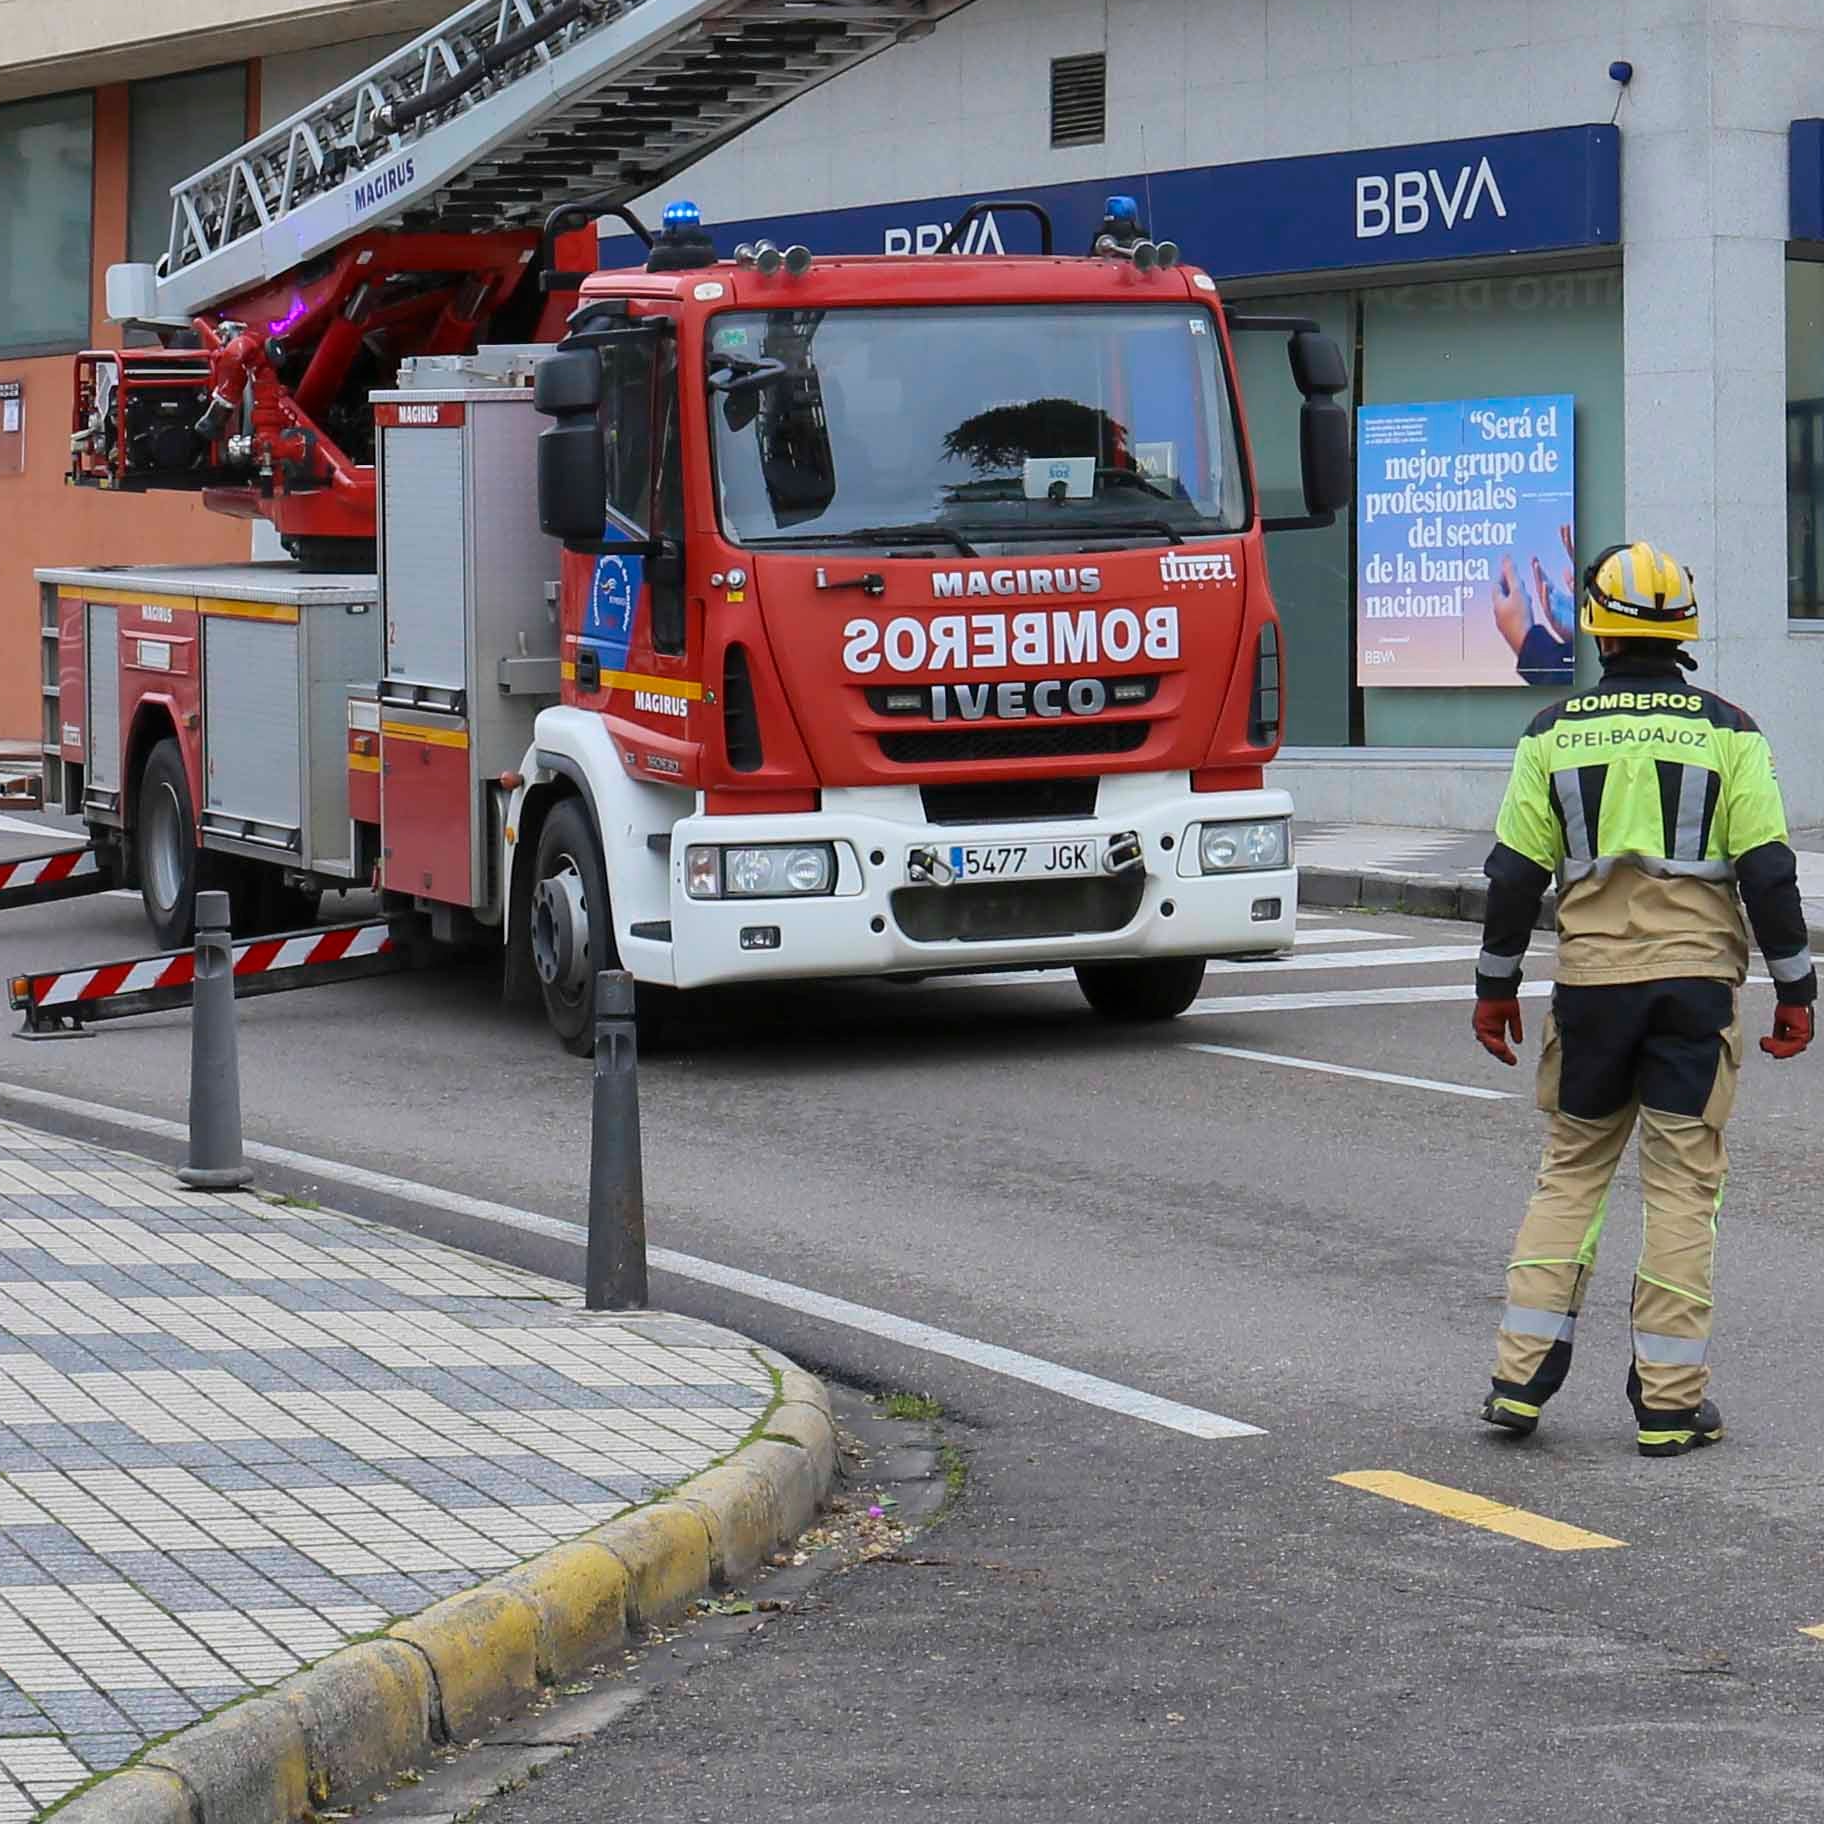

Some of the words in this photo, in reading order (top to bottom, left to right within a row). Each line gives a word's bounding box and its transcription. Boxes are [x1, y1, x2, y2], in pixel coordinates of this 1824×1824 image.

[354, 158, 414, 212] MAGIRUS
[1357, 156, 1506, 238] BBVA
[398, 405, 439, 424] MAGIRUS
[1470, 407, 1532, 440] “Será
[1536, 406, 1558, 438] el
[1385, 449, 1451, 485] mejor
[1454, 450, 1525, 485] grupo
[1529, 442, 1559, 473] de
[1365, 480, 1517, 522] profesionales
[1408, 517, 1443, 549] del
[1446, 520, 1517, 547] sector
[932, 567, 1102, 598] MAGIRUS
[1366, 553, 1393, 584] de
[1396, 552, 1416, 583] la
[1420, 552, 1489, 582] banca
[1365, 586, 1474, 618] nacional”
[1364, 649, 1396, 665] BBVA
[635, 690, 689, 717] MAGIRUS
[930, 679, 1107, 721] IVECO
[1566, 693, 1702, 713] BOMBEROS
[1556, 727, 1708, 748] CPEI-BADAJOZ
[964, 847, 1028, 875] 5477
[1044, 843, 1089, 871] JGK
